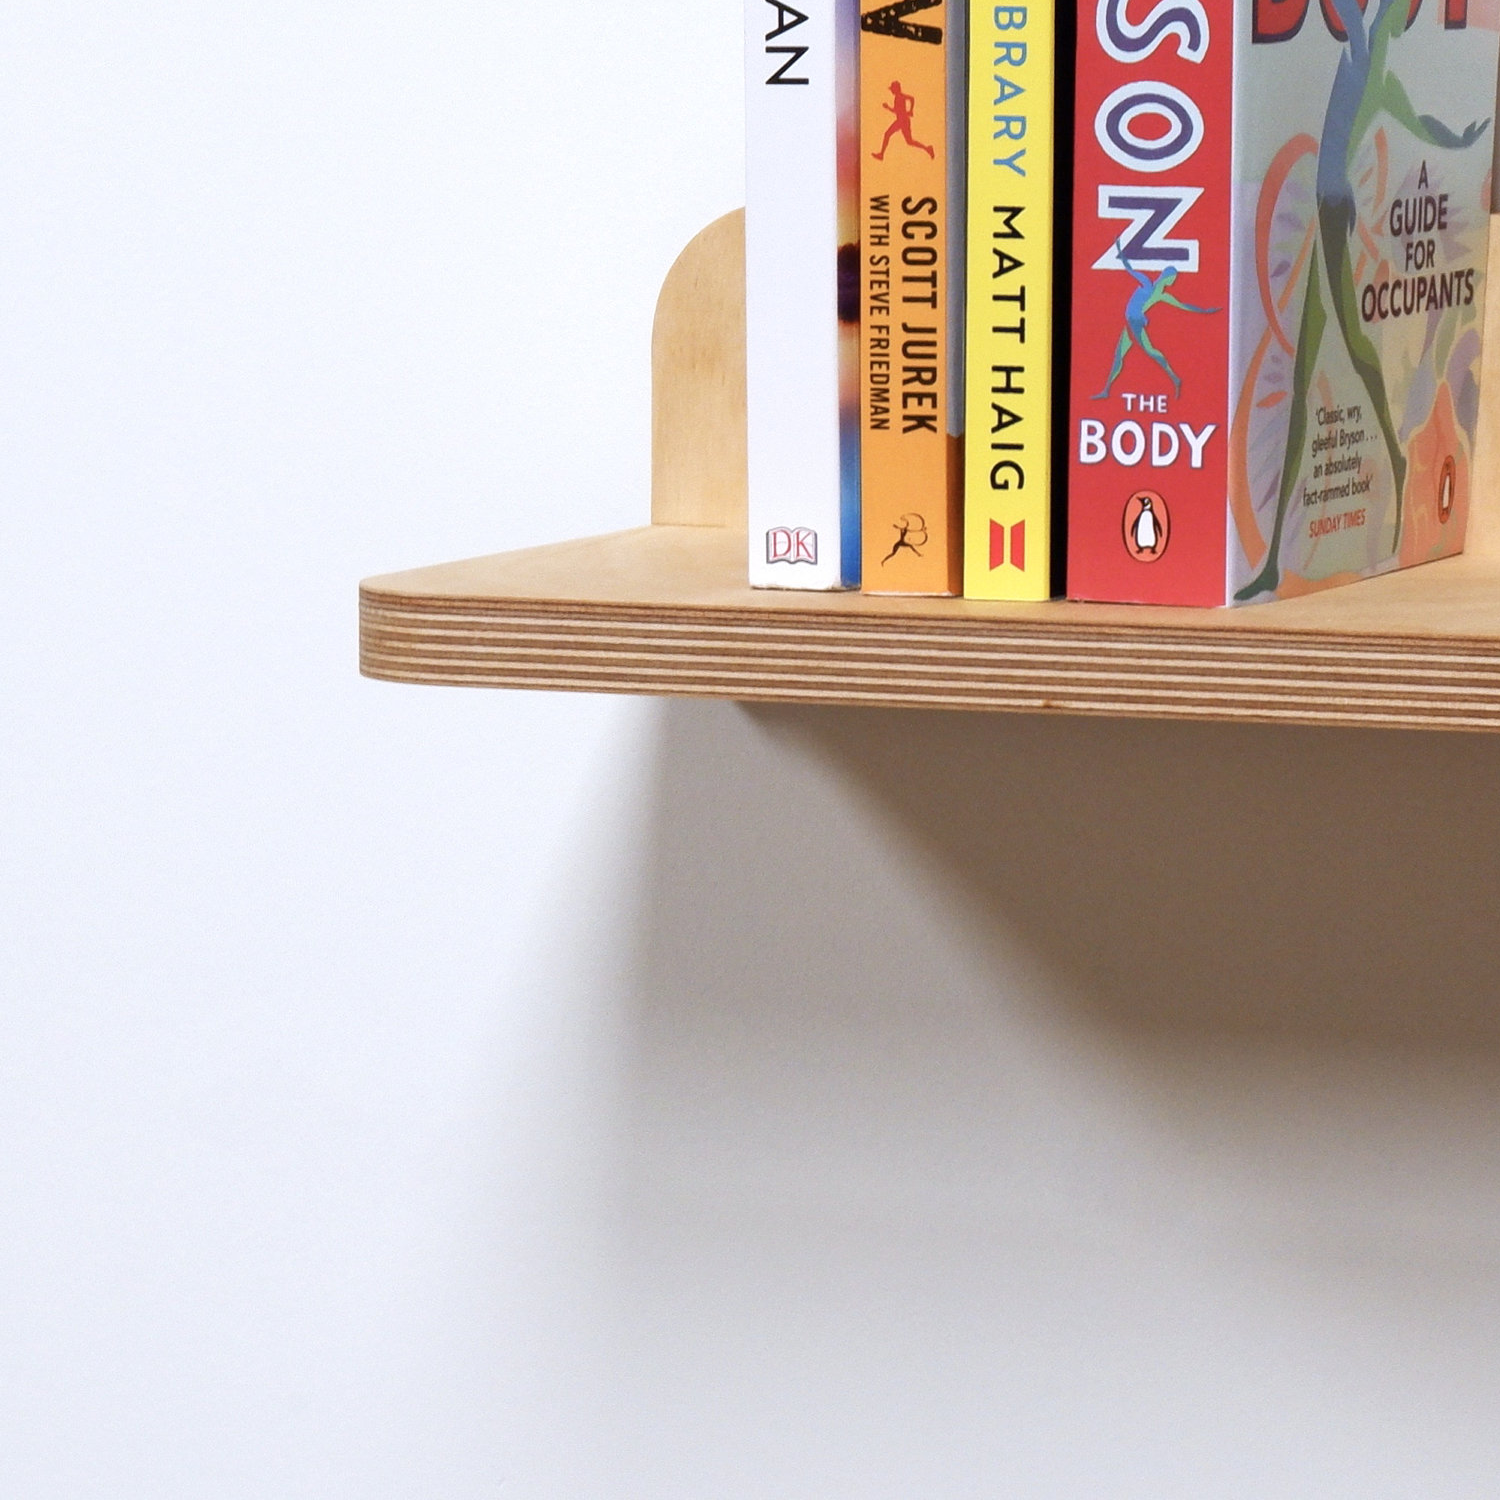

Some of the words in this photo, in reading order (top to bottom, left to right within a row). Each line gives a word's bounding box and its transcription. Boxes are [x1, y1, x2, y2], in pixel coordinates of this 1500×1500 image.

[1418, 160, 1429, 190] A
[869, 194, 890, 246] WITH
[1389, 194, 1449, 238] GUIDE
[901, 196, 938, 309] SCOTT
[991, 205, 1026, 344] MATT
[1405, 239, 1435, 272] FOR
[869, 255, 890, 317] STEVE
[1361, 268, 1475, 323] OCCUPANTS
[869, 325, 890, 431] FRIEDMAN
[901, 322, 938, 435] JUREK
[1122, 393, 1168, 414] THE
[988, 365, 1025, 491] HAIG
[1079, 418, 1217, 469] BODY
[1311, 431, 1338, 458] gleeful
[1313, 464, 1323, 479] an
[1323, 452, 1363, 477] absolutely
[1303, 478, 1351, 507] fact-rammed
[772, 529, 815, 561] DK
[1309, 514, 1342, 539] SUNDAY
[1343, 508, 1366, 529] TIMES
